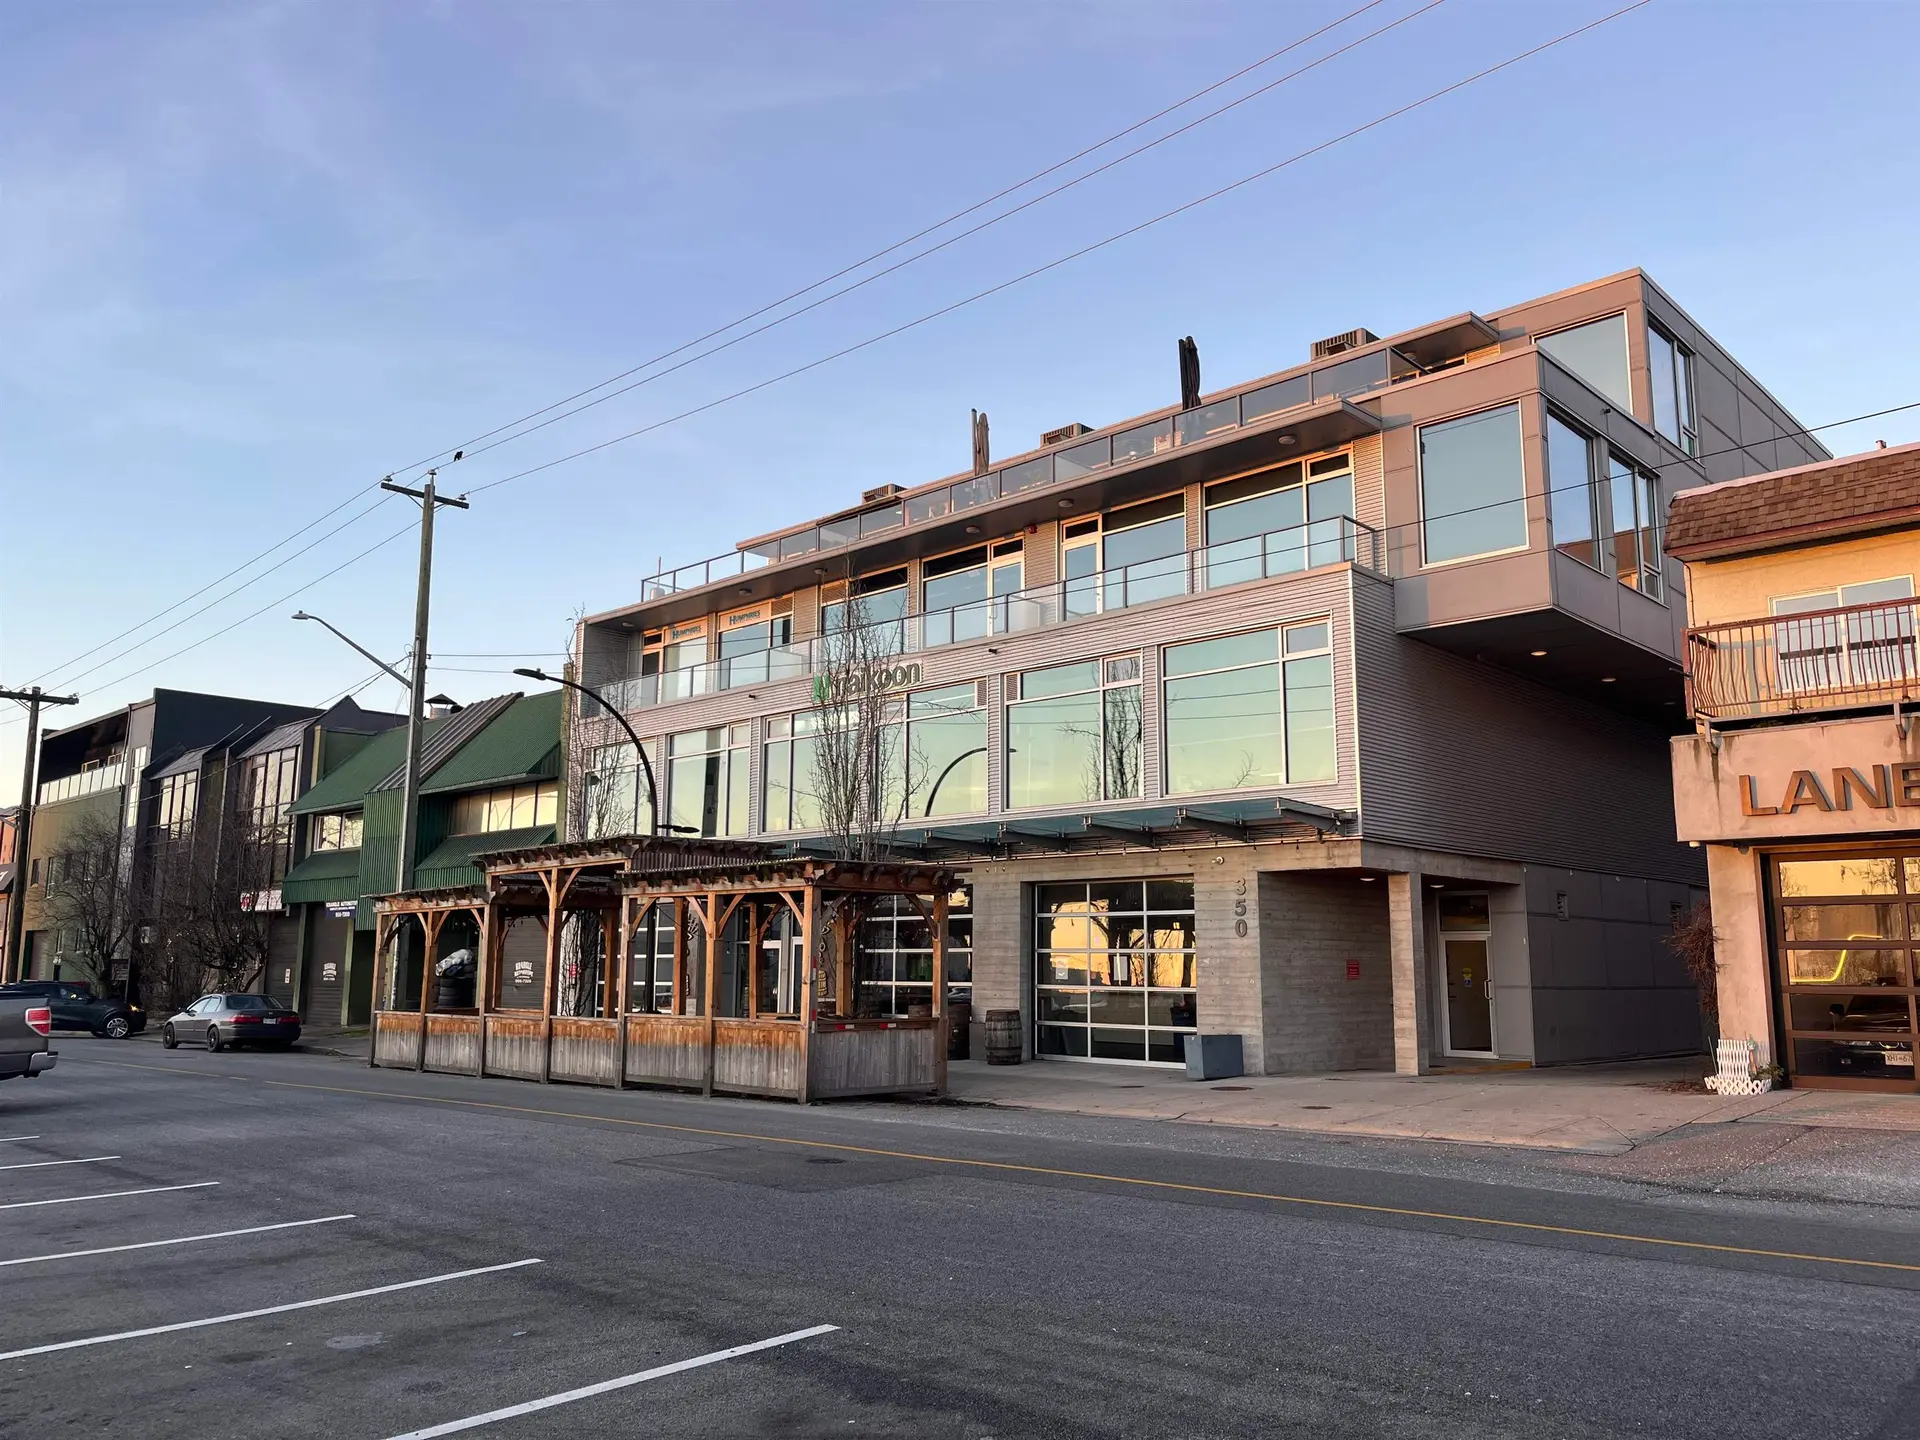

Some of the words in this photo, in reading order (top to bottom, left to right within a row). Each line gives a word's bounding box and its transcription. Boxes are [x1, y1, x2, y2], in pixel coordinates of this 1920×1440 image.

[834, 662, 922, 697] naikoon
[1738, 762, 1920, 817] LANE
[1234, 877, 1248, 938] 350
